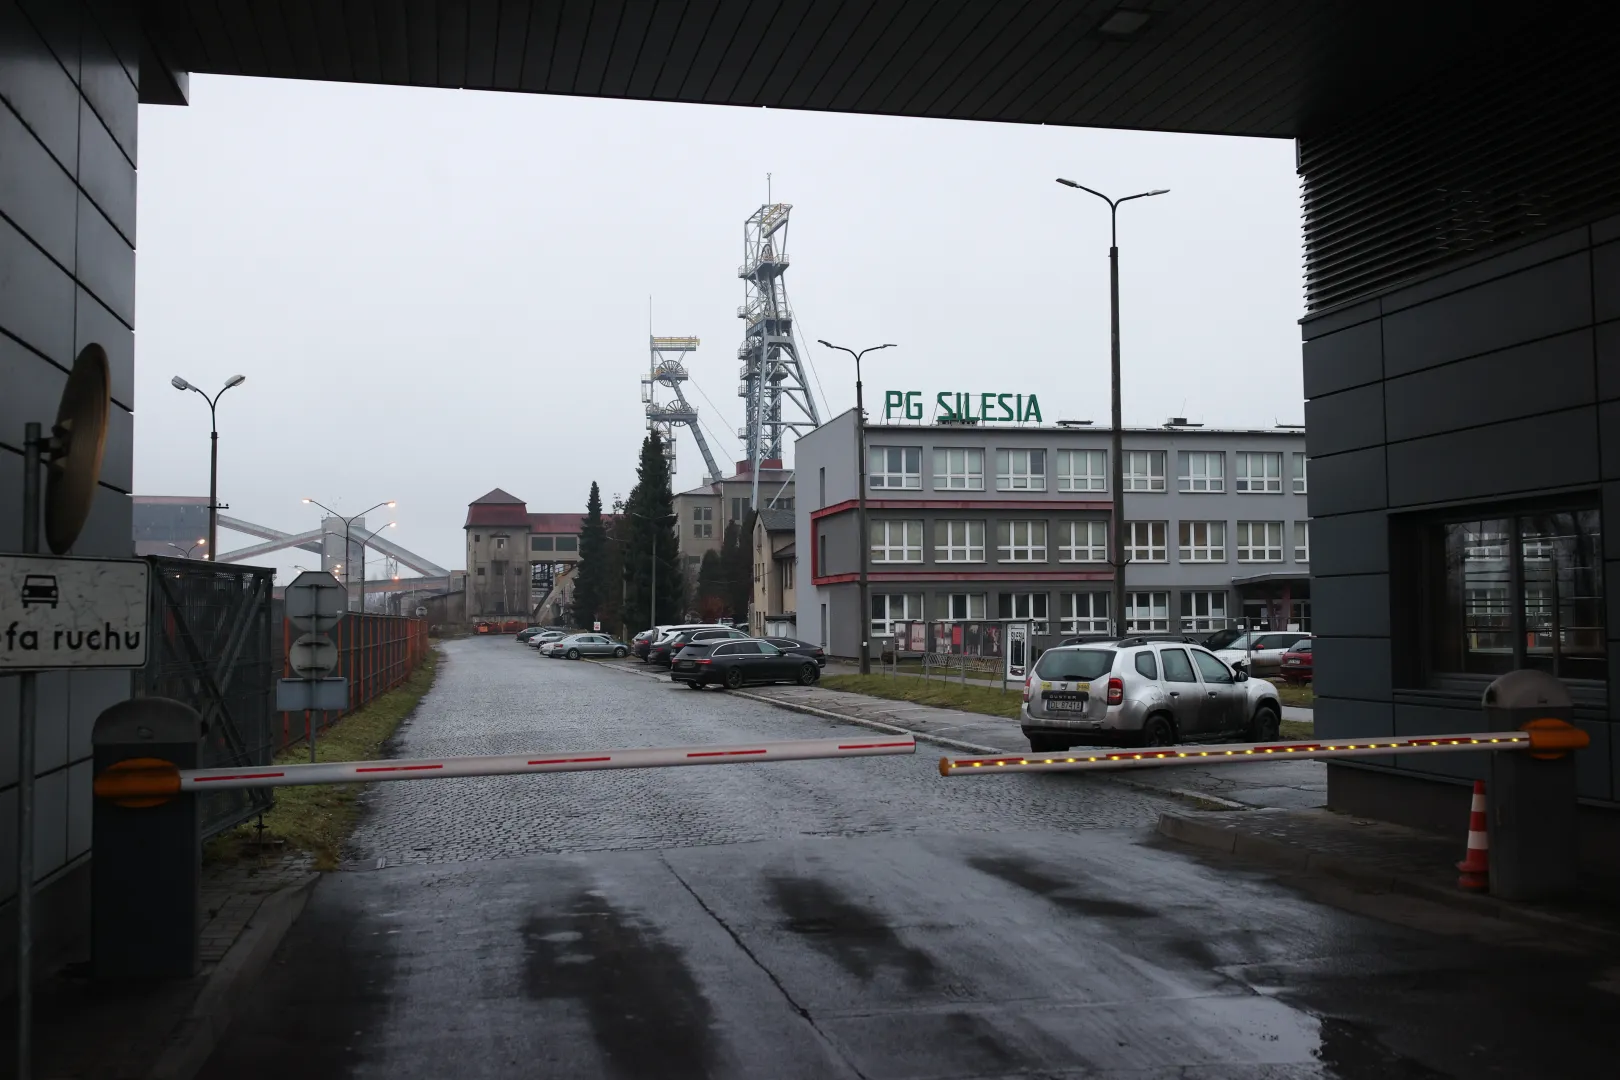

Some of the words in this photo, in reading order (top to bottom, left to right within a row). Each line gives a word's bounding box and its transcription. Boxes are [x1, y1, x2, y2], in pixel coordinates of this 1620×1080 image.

[886, 390, 923, 420] PG
[937, 392, 1043, 422] SILESIA
[0, 621, 38, 651] fa
[53, 621, 140, 650] ruchu
